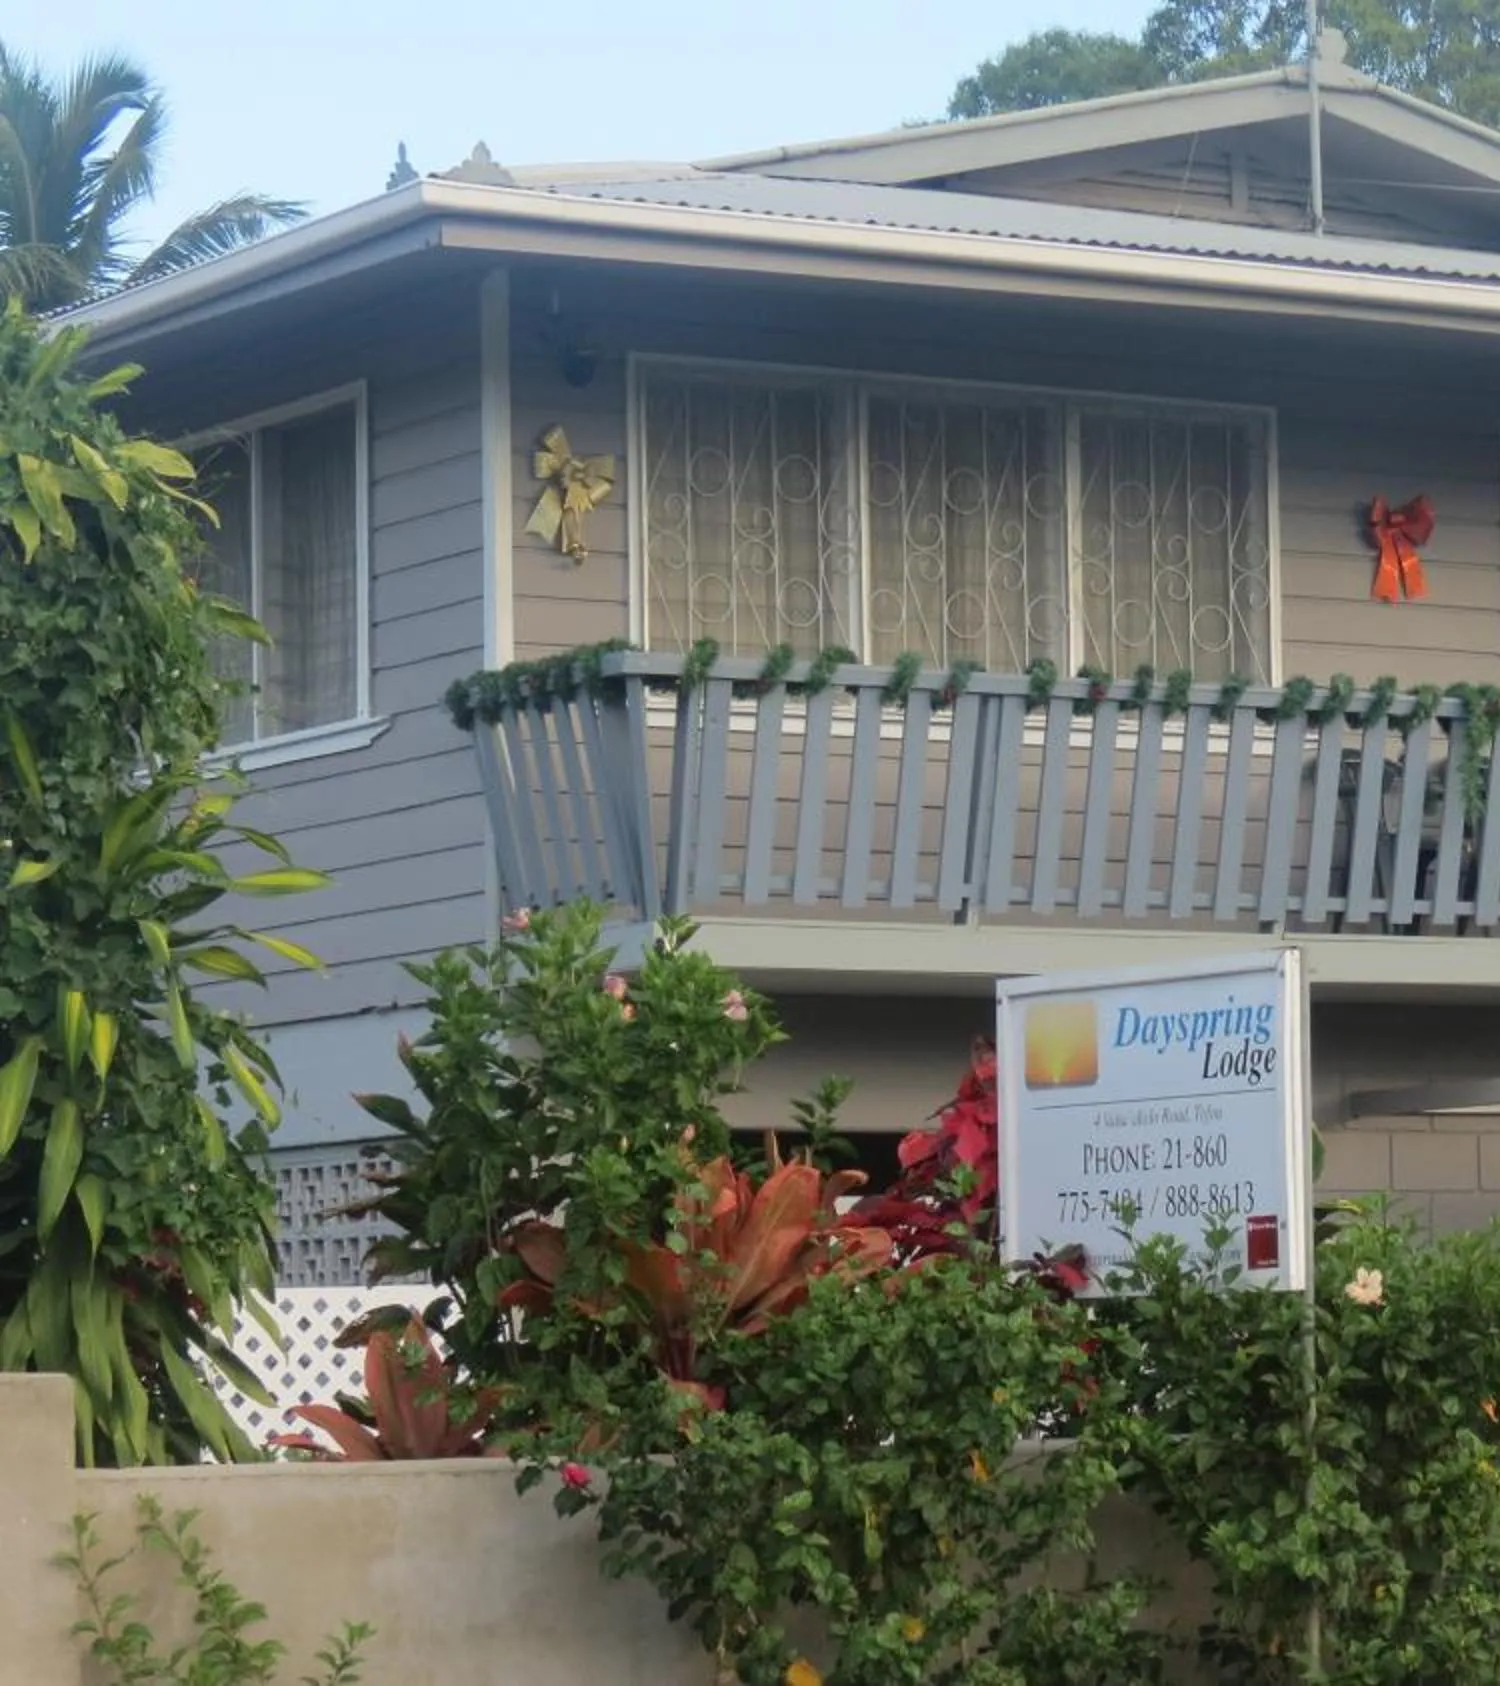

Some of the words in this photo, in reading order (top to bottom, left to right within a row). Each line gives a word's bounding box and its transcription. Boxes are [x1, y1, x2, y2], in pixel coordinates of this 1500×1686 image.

[1114, 996, 1274, 1053] Dayspring
[1202, 1038, 1276, 1085] Lodge
[1083, 1143, 1155, 1175] PHONE:
[1163, 1134, 1228, 1169] 21-860
[1165, 1181, 1255, 1217] 888-8613
